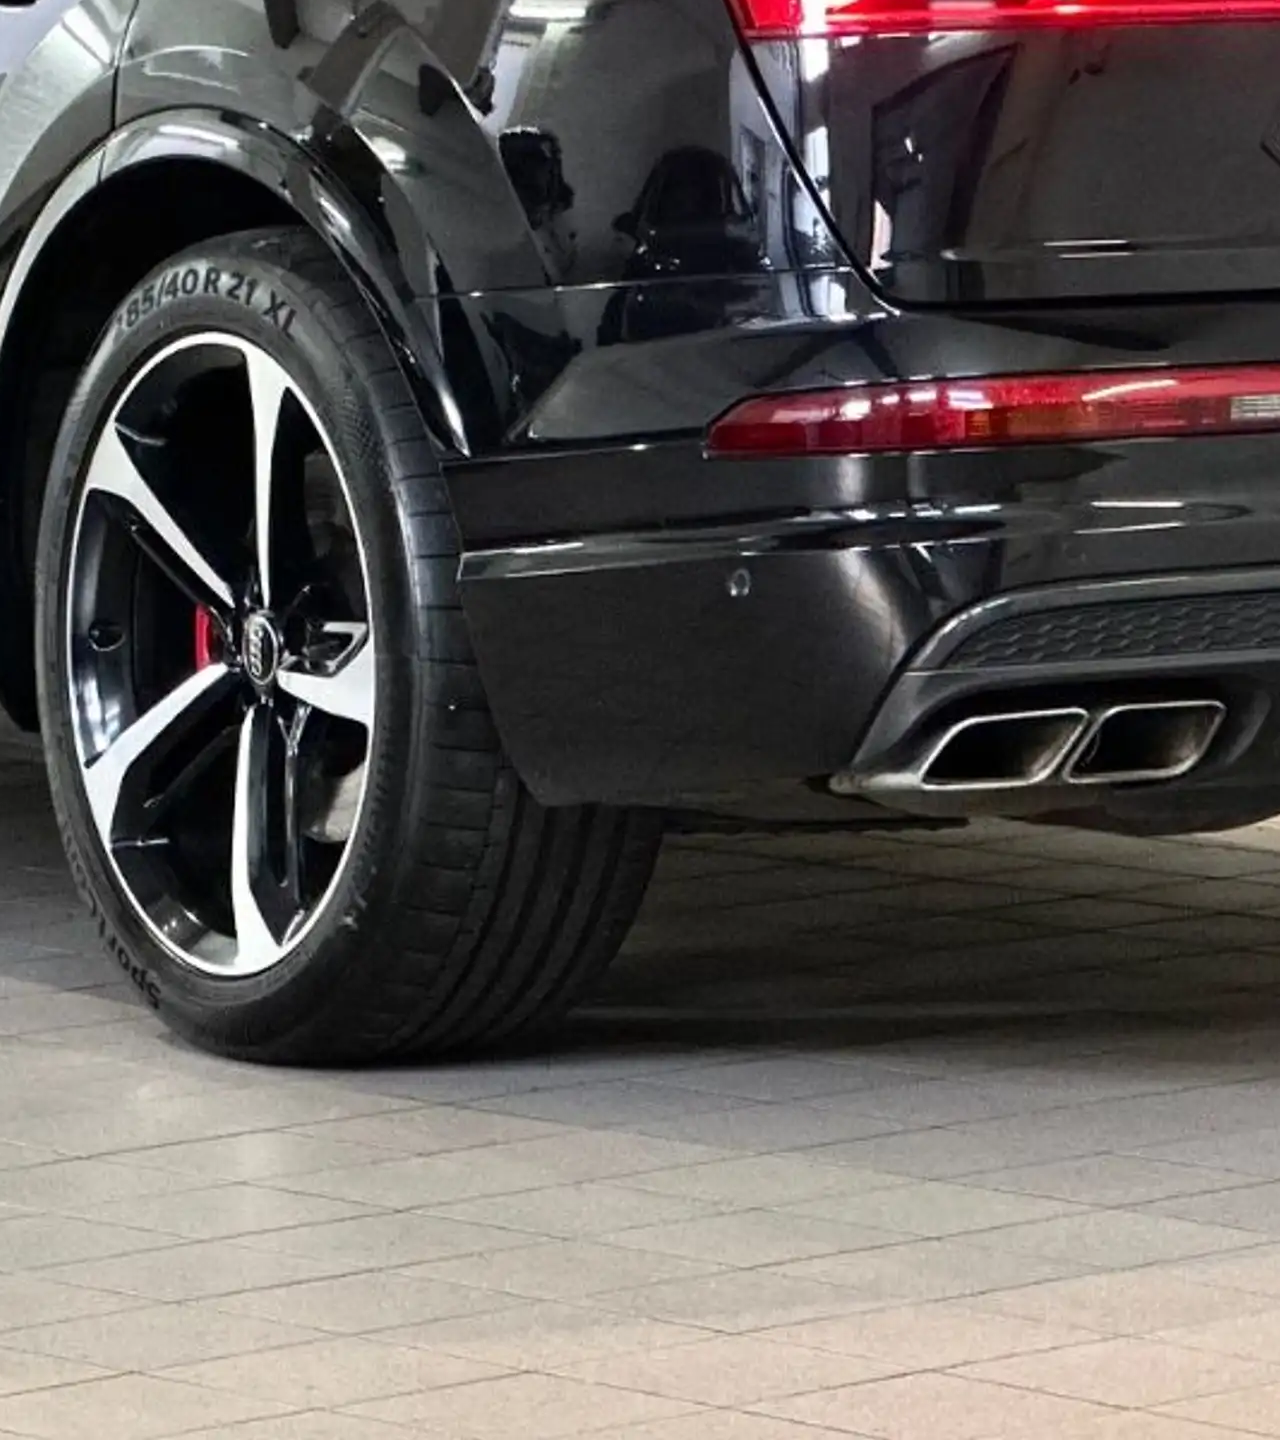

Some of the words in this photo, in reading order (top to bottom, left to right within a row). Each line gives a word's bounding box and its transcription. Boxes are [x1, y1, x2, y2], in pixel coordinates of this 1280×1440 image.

[203, 268, 220, 296] R
[227, 273, 259, 306] 21
[262, 290, 297, 339] XL
